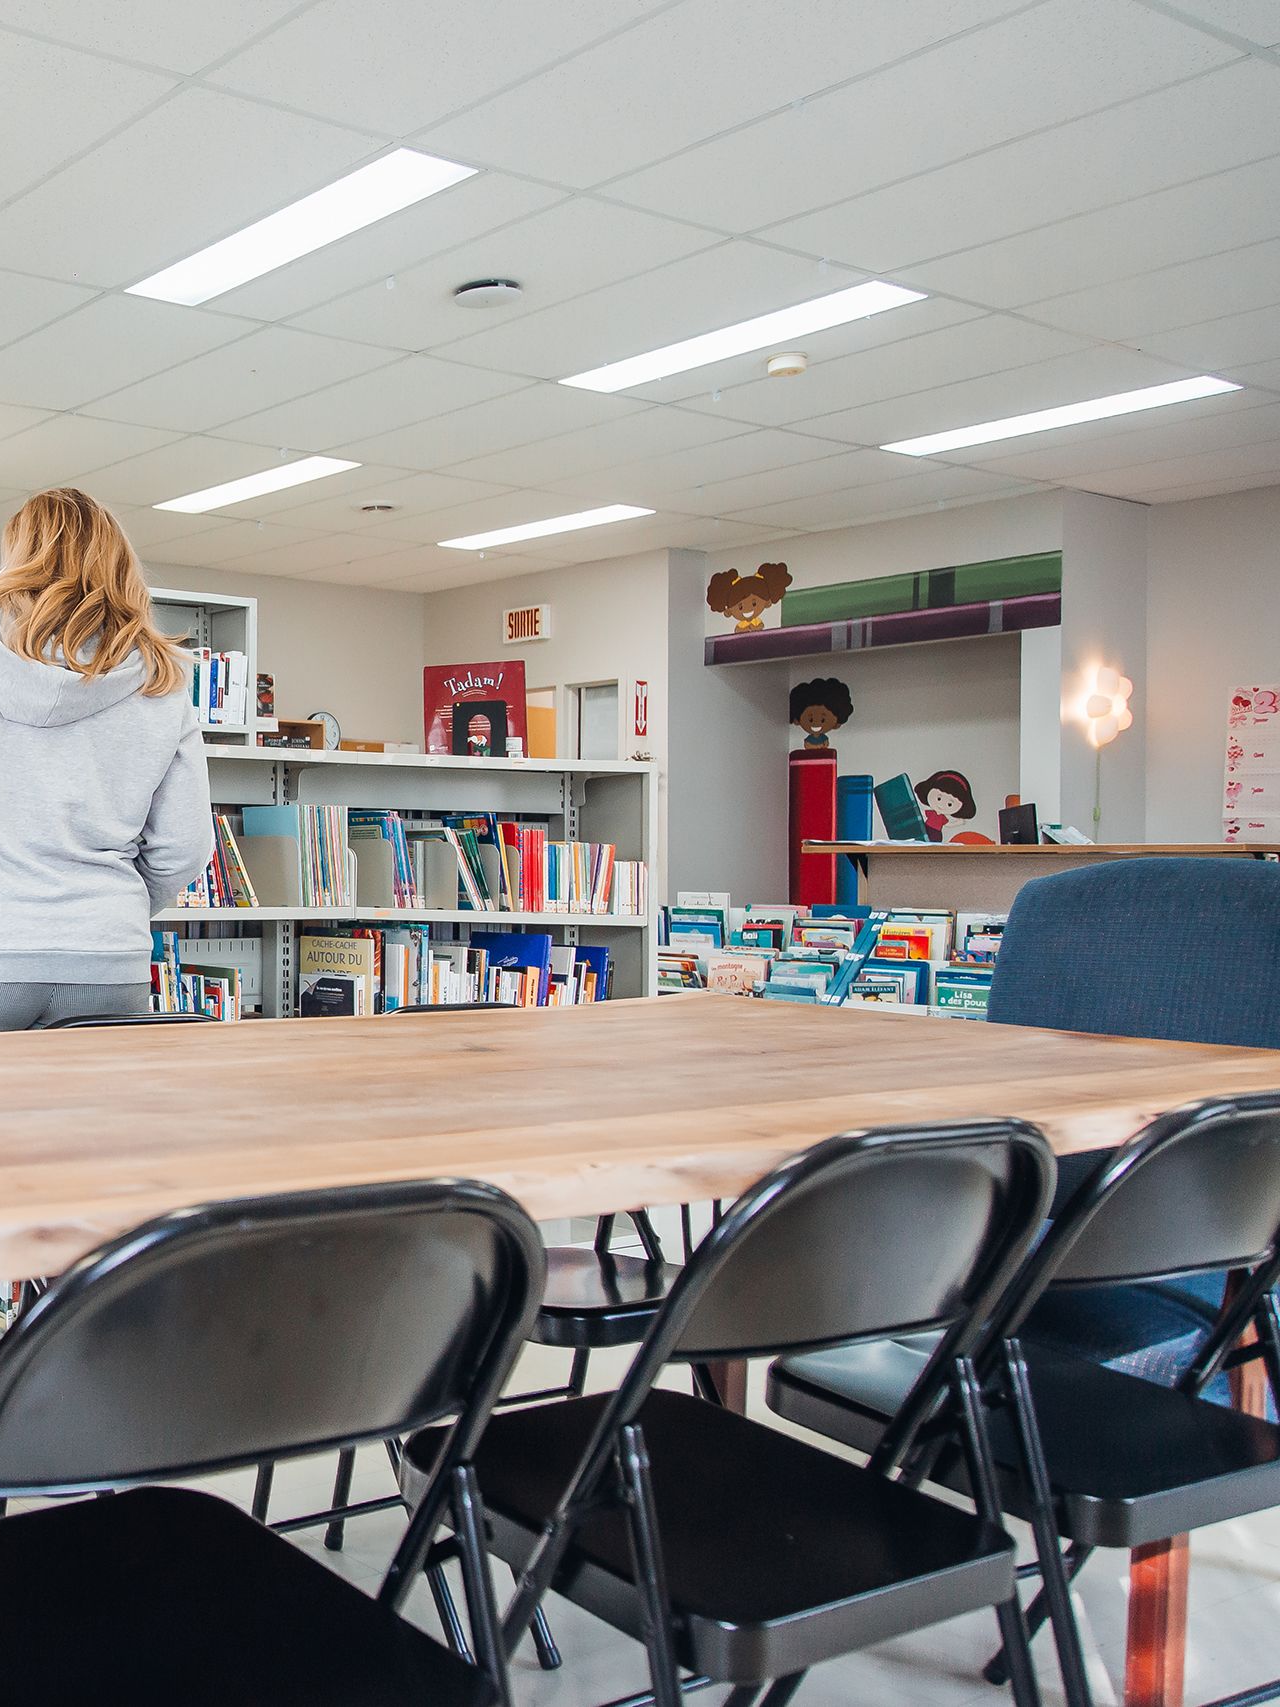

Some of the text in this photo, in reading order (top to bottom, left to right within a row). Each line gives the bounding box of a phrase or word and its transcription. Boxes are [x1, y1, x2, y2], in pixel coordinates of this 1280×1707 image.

[508, 608, 539, 640] SORTIE
[444, 672, 504, 696] Tadam!
[312, 939, 357, 950] CACHE-CACHE
[307, 951, 362, 965] AUTOUR DU
[954, 990, 973, 1000] Lisa
[948, 996, 962, 1006] des
[964, 996, 988, 1009] poux
